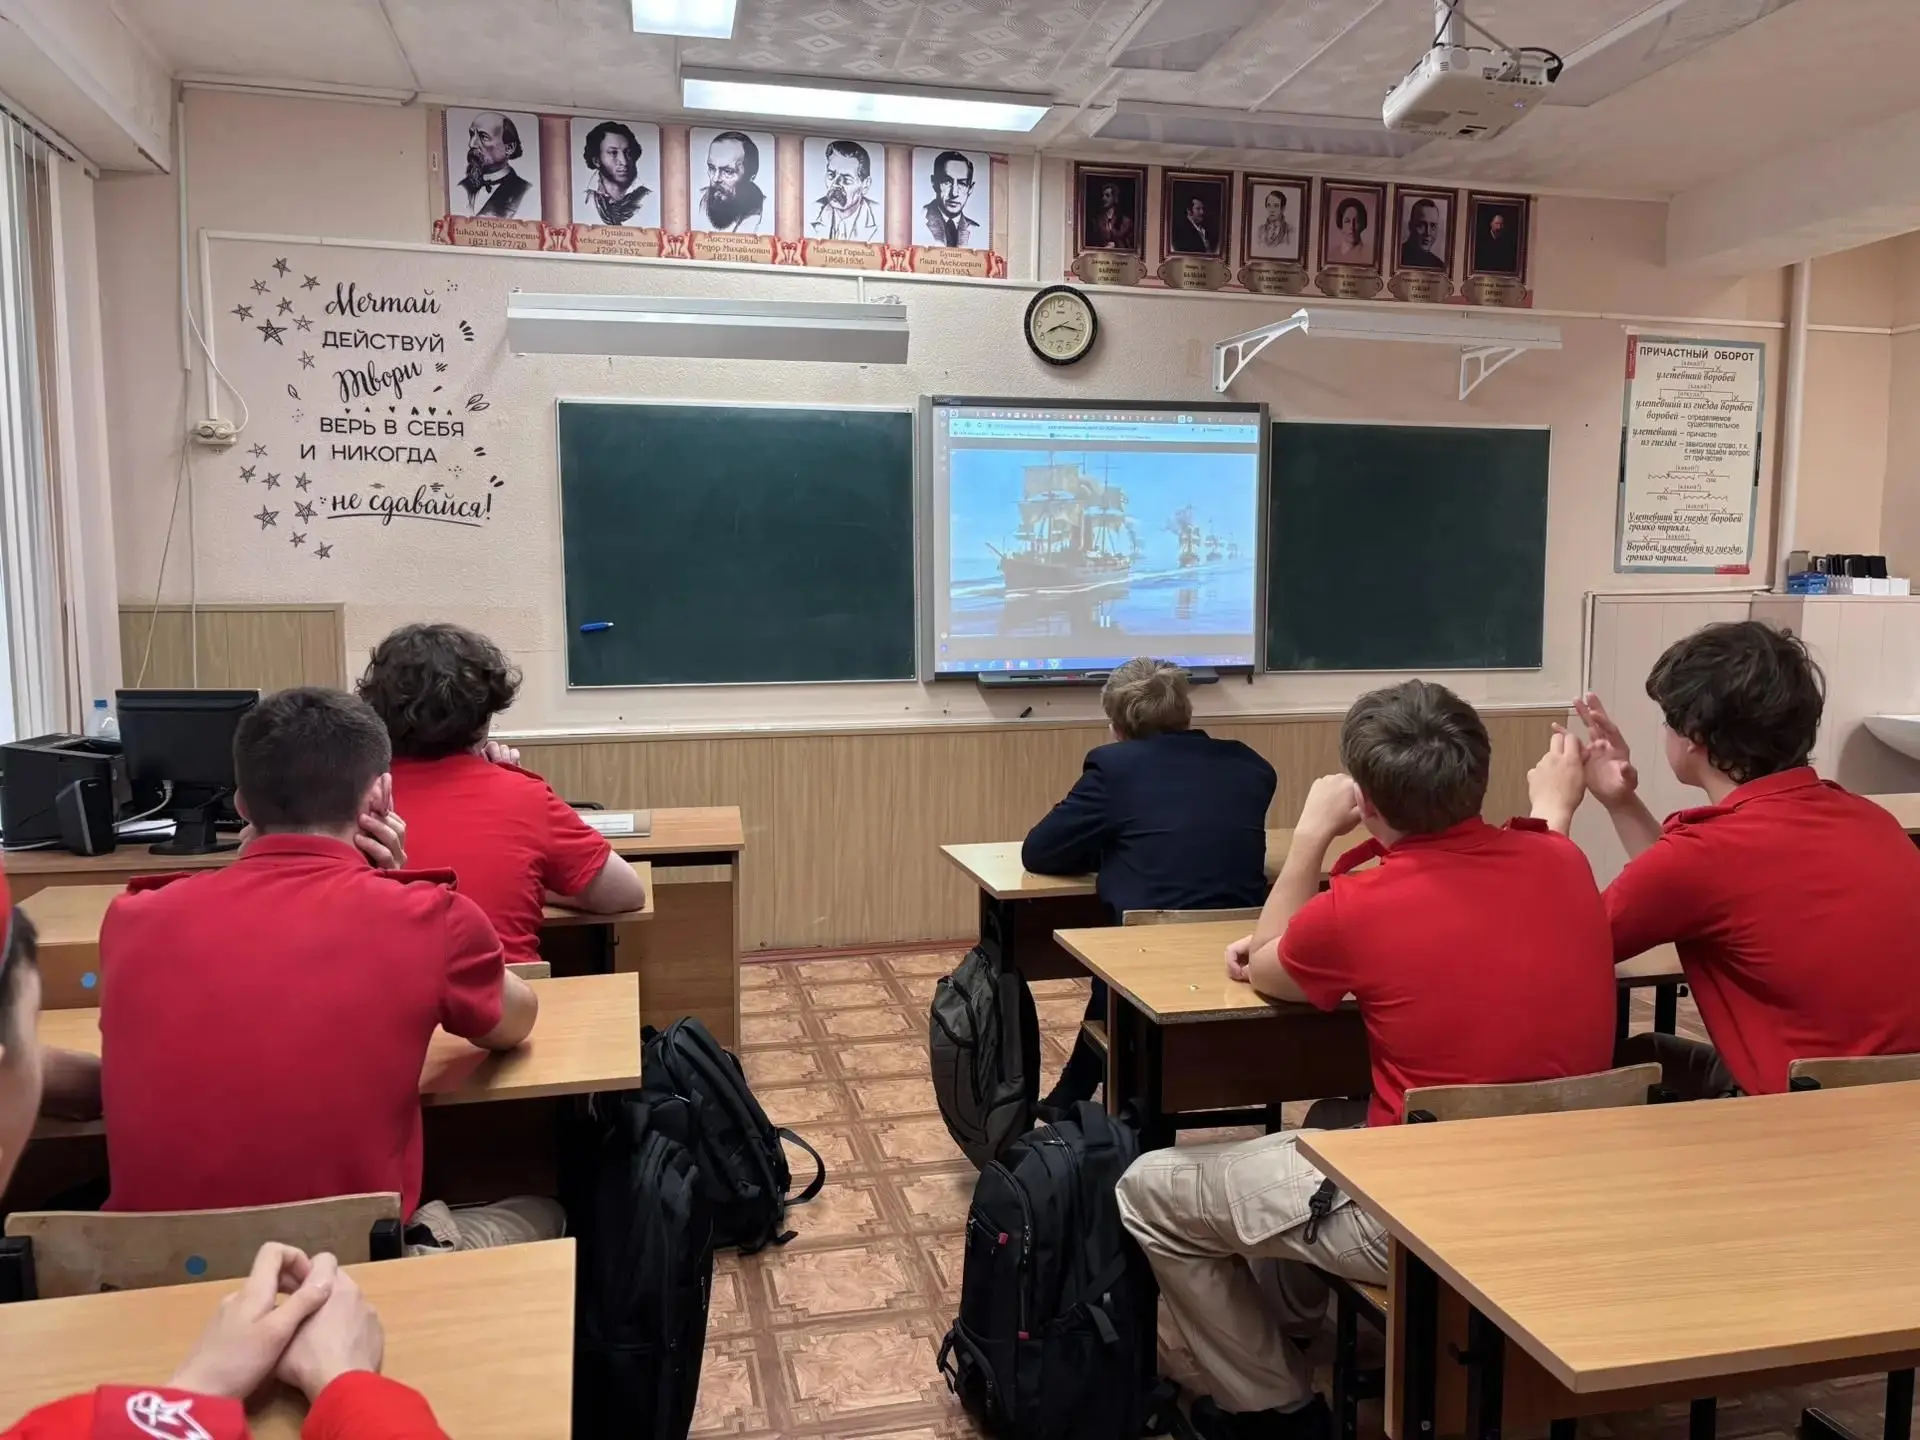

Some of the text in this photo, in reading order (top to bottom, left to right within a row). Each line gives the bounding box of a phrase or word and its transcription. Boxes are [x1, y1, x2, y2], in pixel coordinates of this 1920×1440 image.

[476, 220, 517, 230] Некрасов
[453, 228, 541, 241] Николай Алексеевич
[601, 229, 634, 238] Пушкин
[722, 245, 771, 255] Михайлович
[813, 246, 876, 257] Максим Горький
[712, 253, 754, 262] 1821-1881
[325, 281, 442, 318] Мечтай
[322, 329, 445, 353] ДЕЙСТВУЙ
[1639, 346, 1755, 361] ПРИЧАСТНЫЙ ОБОРОТ
[333, 360, 422, 403] Твори
[1655, 370, 1736, 383] улетевший воробей
[1635, 399, 1753, 412] улетевший из гнезда воробей
[1646, 410, 1678, 421] воробей
[320, 417, 464, 437] ВЕРЬ В СЕБЯ
[1632, 427, 1677, 438] улетевший
[300, 444, 438, 464] И НИКОГДА
[332, 484, 492, 526] не сдавайся!
[1629, 512, 1742, 524] Улетевший из гнезда воробей
[1628, 523, 1655, 532] громко
[1625, 554, 1653, 563] громко
